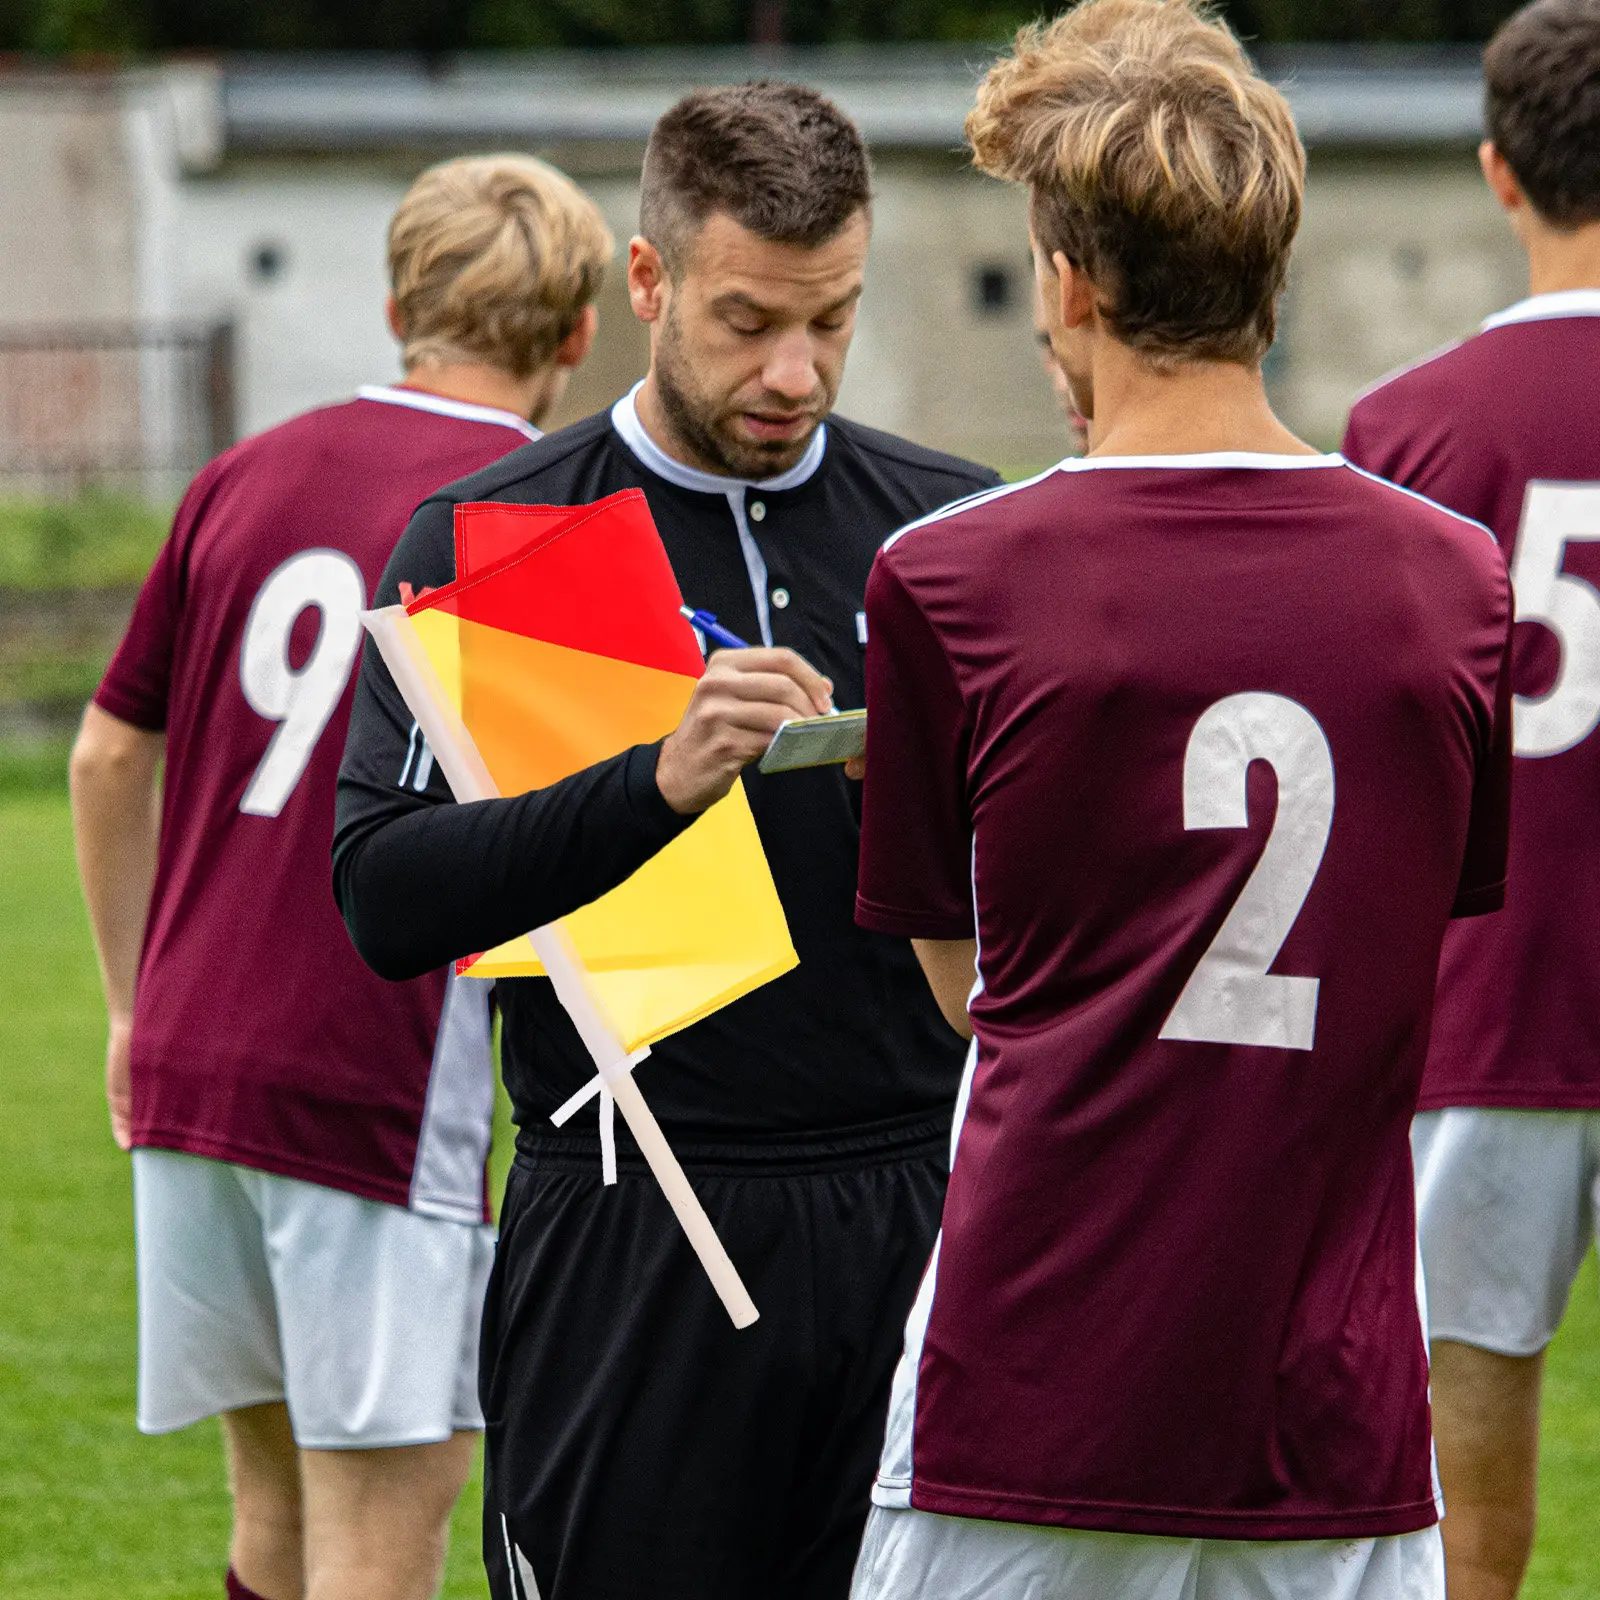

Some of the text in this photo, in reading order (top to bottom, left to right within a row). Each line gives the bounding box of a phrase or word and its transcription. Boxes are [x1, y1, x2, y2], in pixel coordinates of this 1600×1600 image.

[239, 547, 366, 818] 9
[1511, 479, 1600, 758] 5
[1158, 691, 1335, 1050] 2
